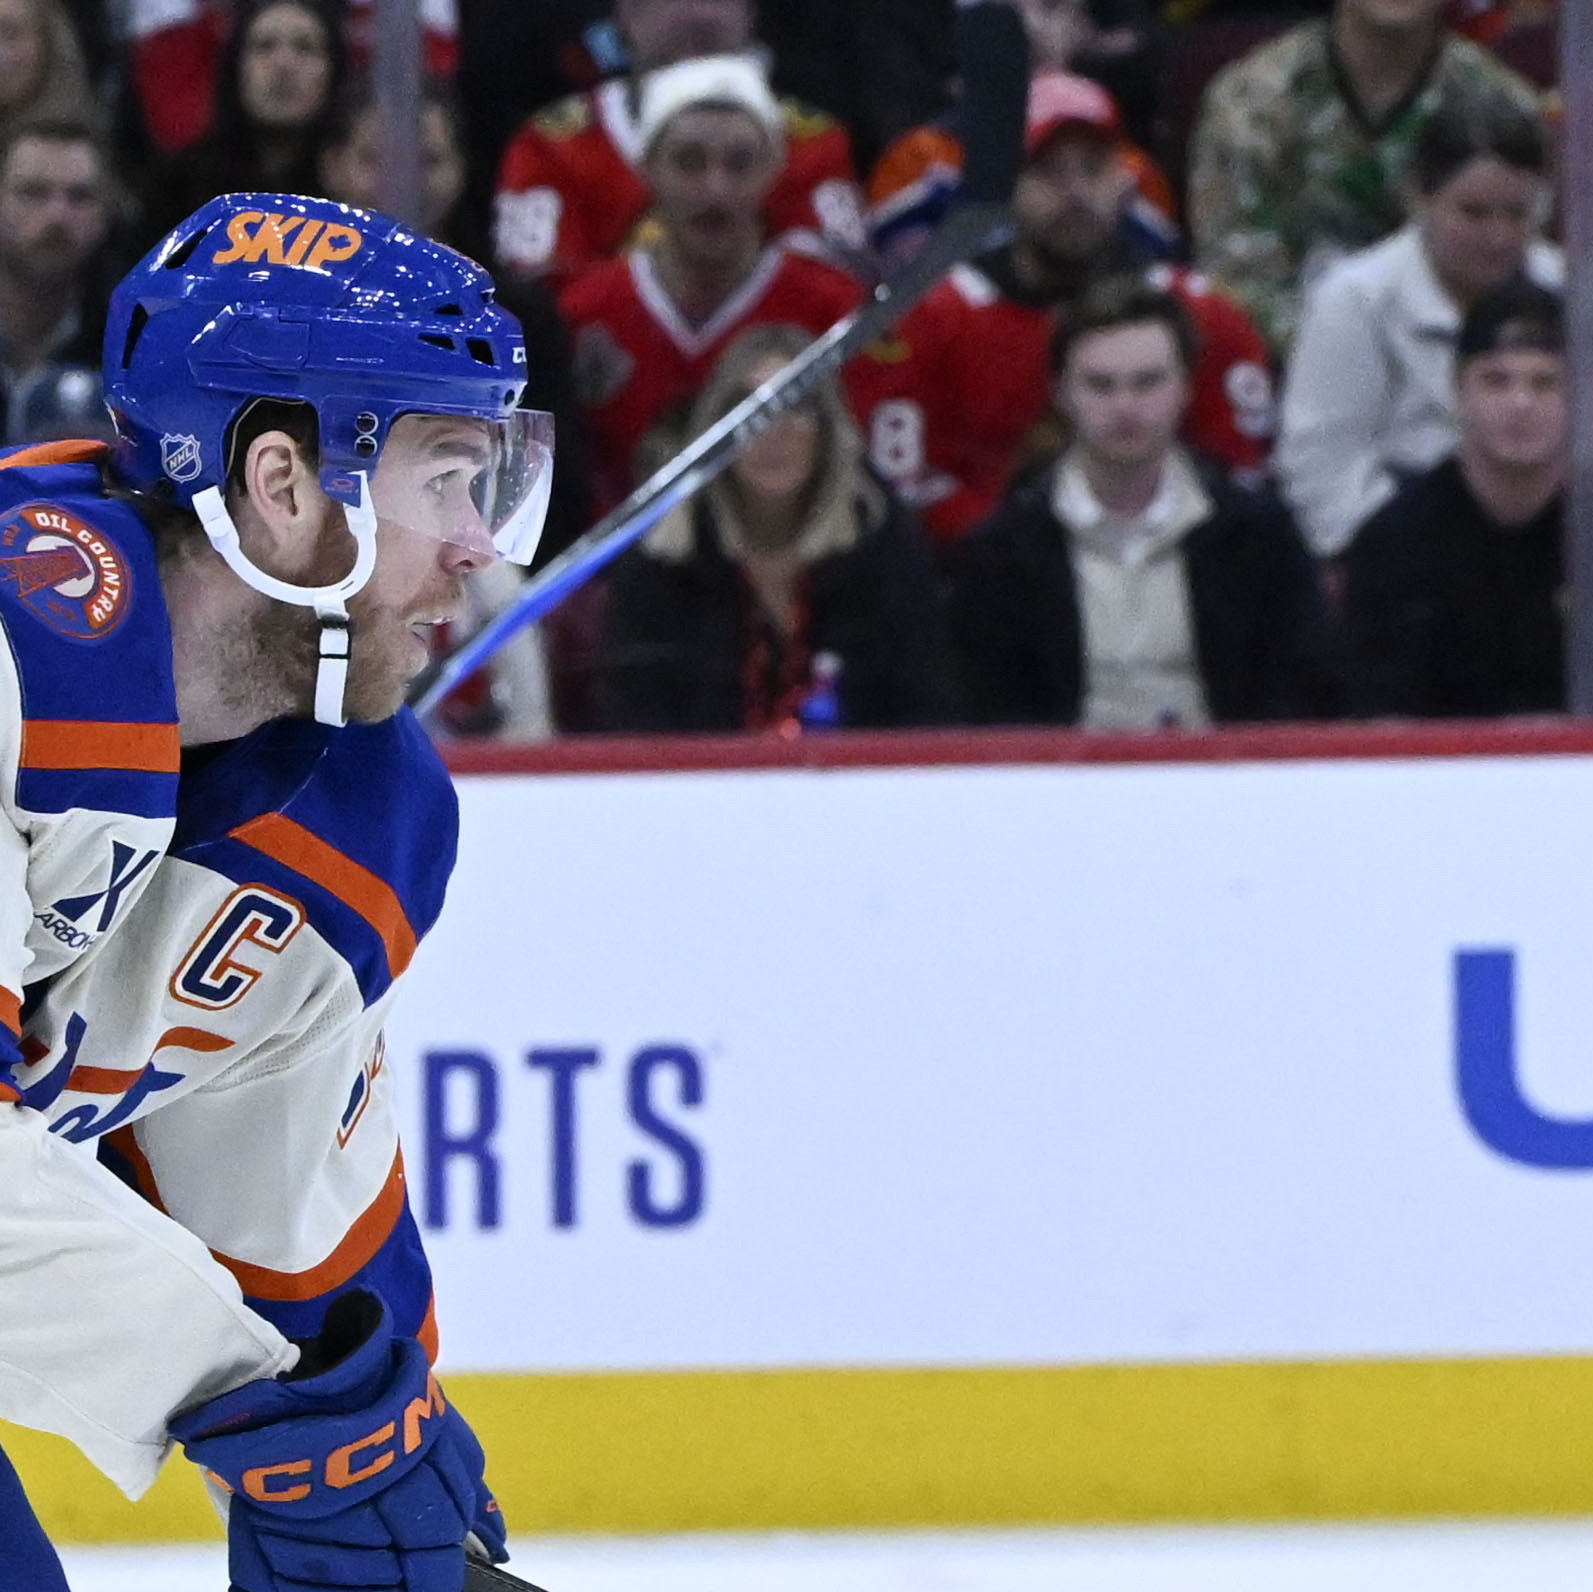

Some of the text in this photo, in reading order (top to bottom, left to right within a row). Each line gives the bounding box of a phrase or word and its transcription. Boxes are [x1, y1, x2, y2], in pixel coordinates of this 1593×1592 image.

[212, 210, 363, 268] SKIP
[169, 447, 193, 470] NHL
[34, 511, 121, 623] OIL COUNTRY
[33, 911, 95, 950] ARBO
[168, 882, 307, 1011] C
[421, 1044, 704, 1232] RTS
[241, 1371, 446, 1502] CCM
